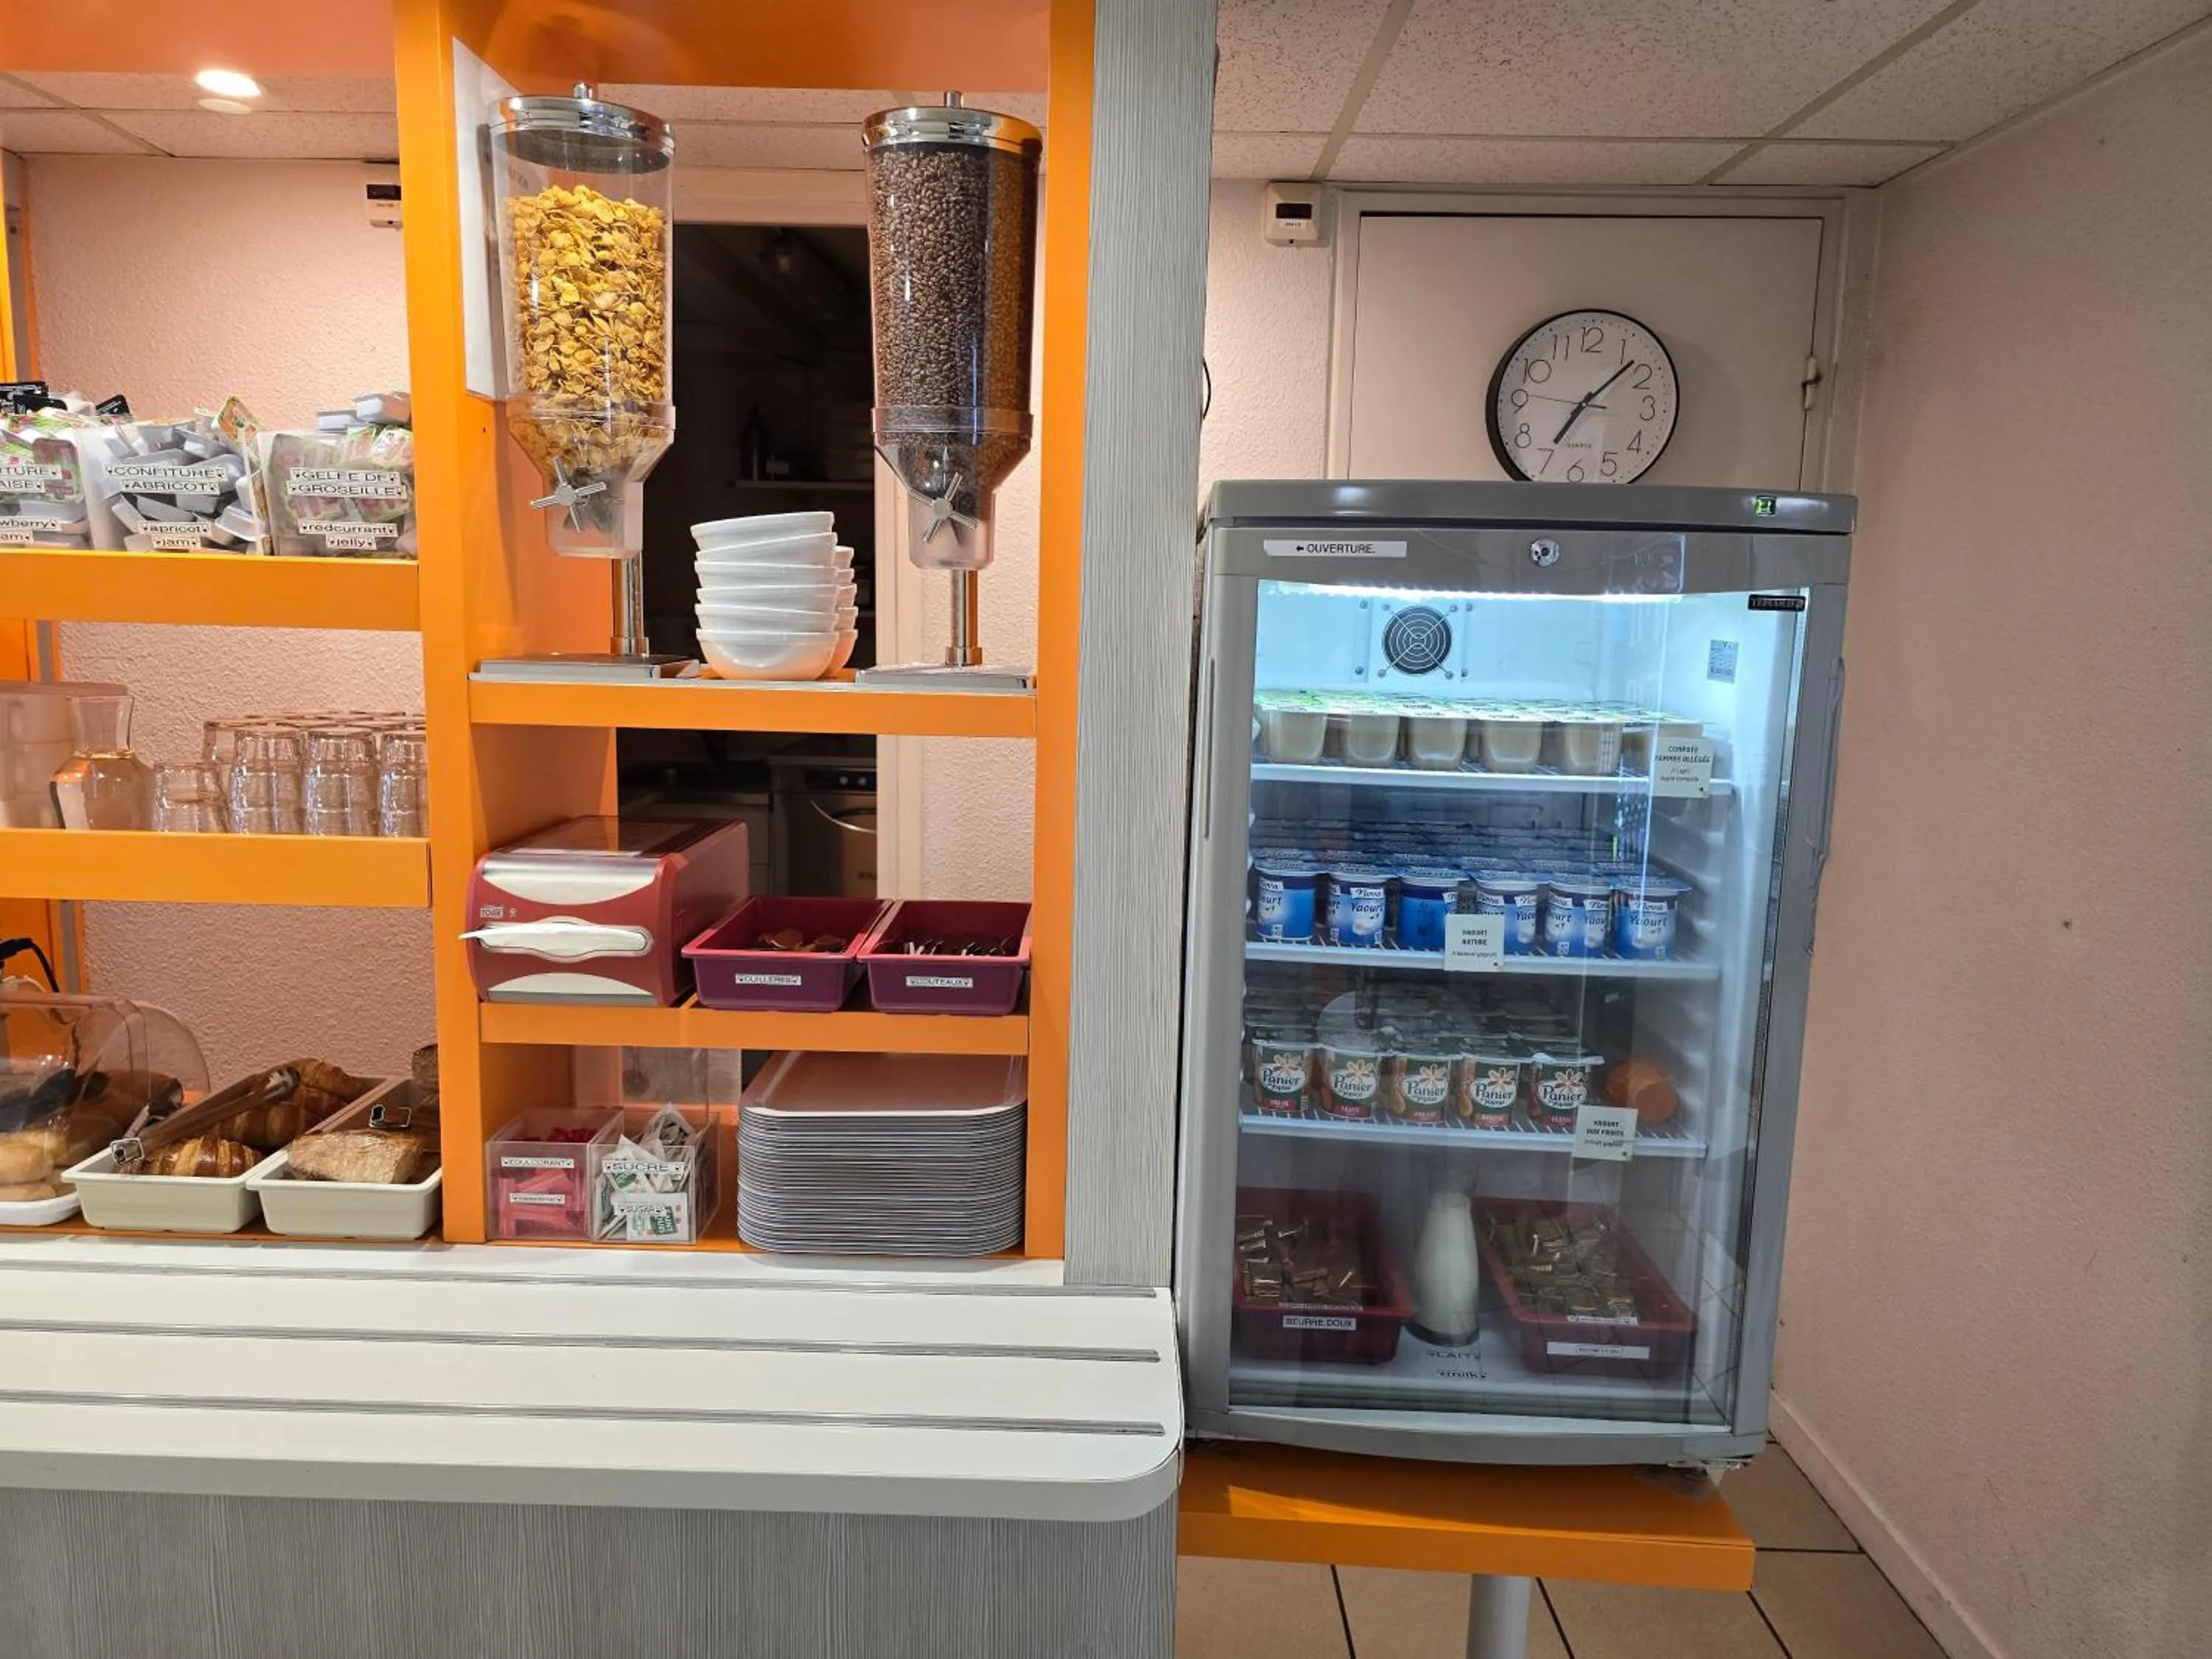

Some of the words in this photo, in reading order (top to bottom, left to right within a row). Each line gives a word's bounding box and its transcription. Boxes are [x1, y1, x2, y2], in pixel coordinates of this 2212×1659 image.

[1552, 334, 1571, 361] 11
[1580, 326, 1604, 353] 12
[1619, 338, 1626, 365] 1
[1523, 357, 1551, 384] 10
[1632, 363, 1652, 389] 2
[1511, 389, 1528, 414] 9
[1639, 395, 1655, 421] 3
[1514, 422, 1531, 448] 8
[1627, 429, 1642, 454] 4
[114, 466, 216, 479] CONFITURE
[1537, 447, 1554, 474] 7
[1567, 459, 1585, 483] 6
[1600, 451, 1618, 476] 5
[131, 481, 206, 491] ABRICOT
[150, 525, 201, 534] apricot
[309, 523, 387, 534] redcurrant
[336, 537, 366, 547] jelly
[1263, 1068, 1301, 1085] Panier
[1334, 1074, 1371, 1091] Panier
[1407, 1080, 1444, 1095] Panier
[1474, 1083, 1514, 1099] Panier
[1543, 1085, 1582, 1101] Panier
